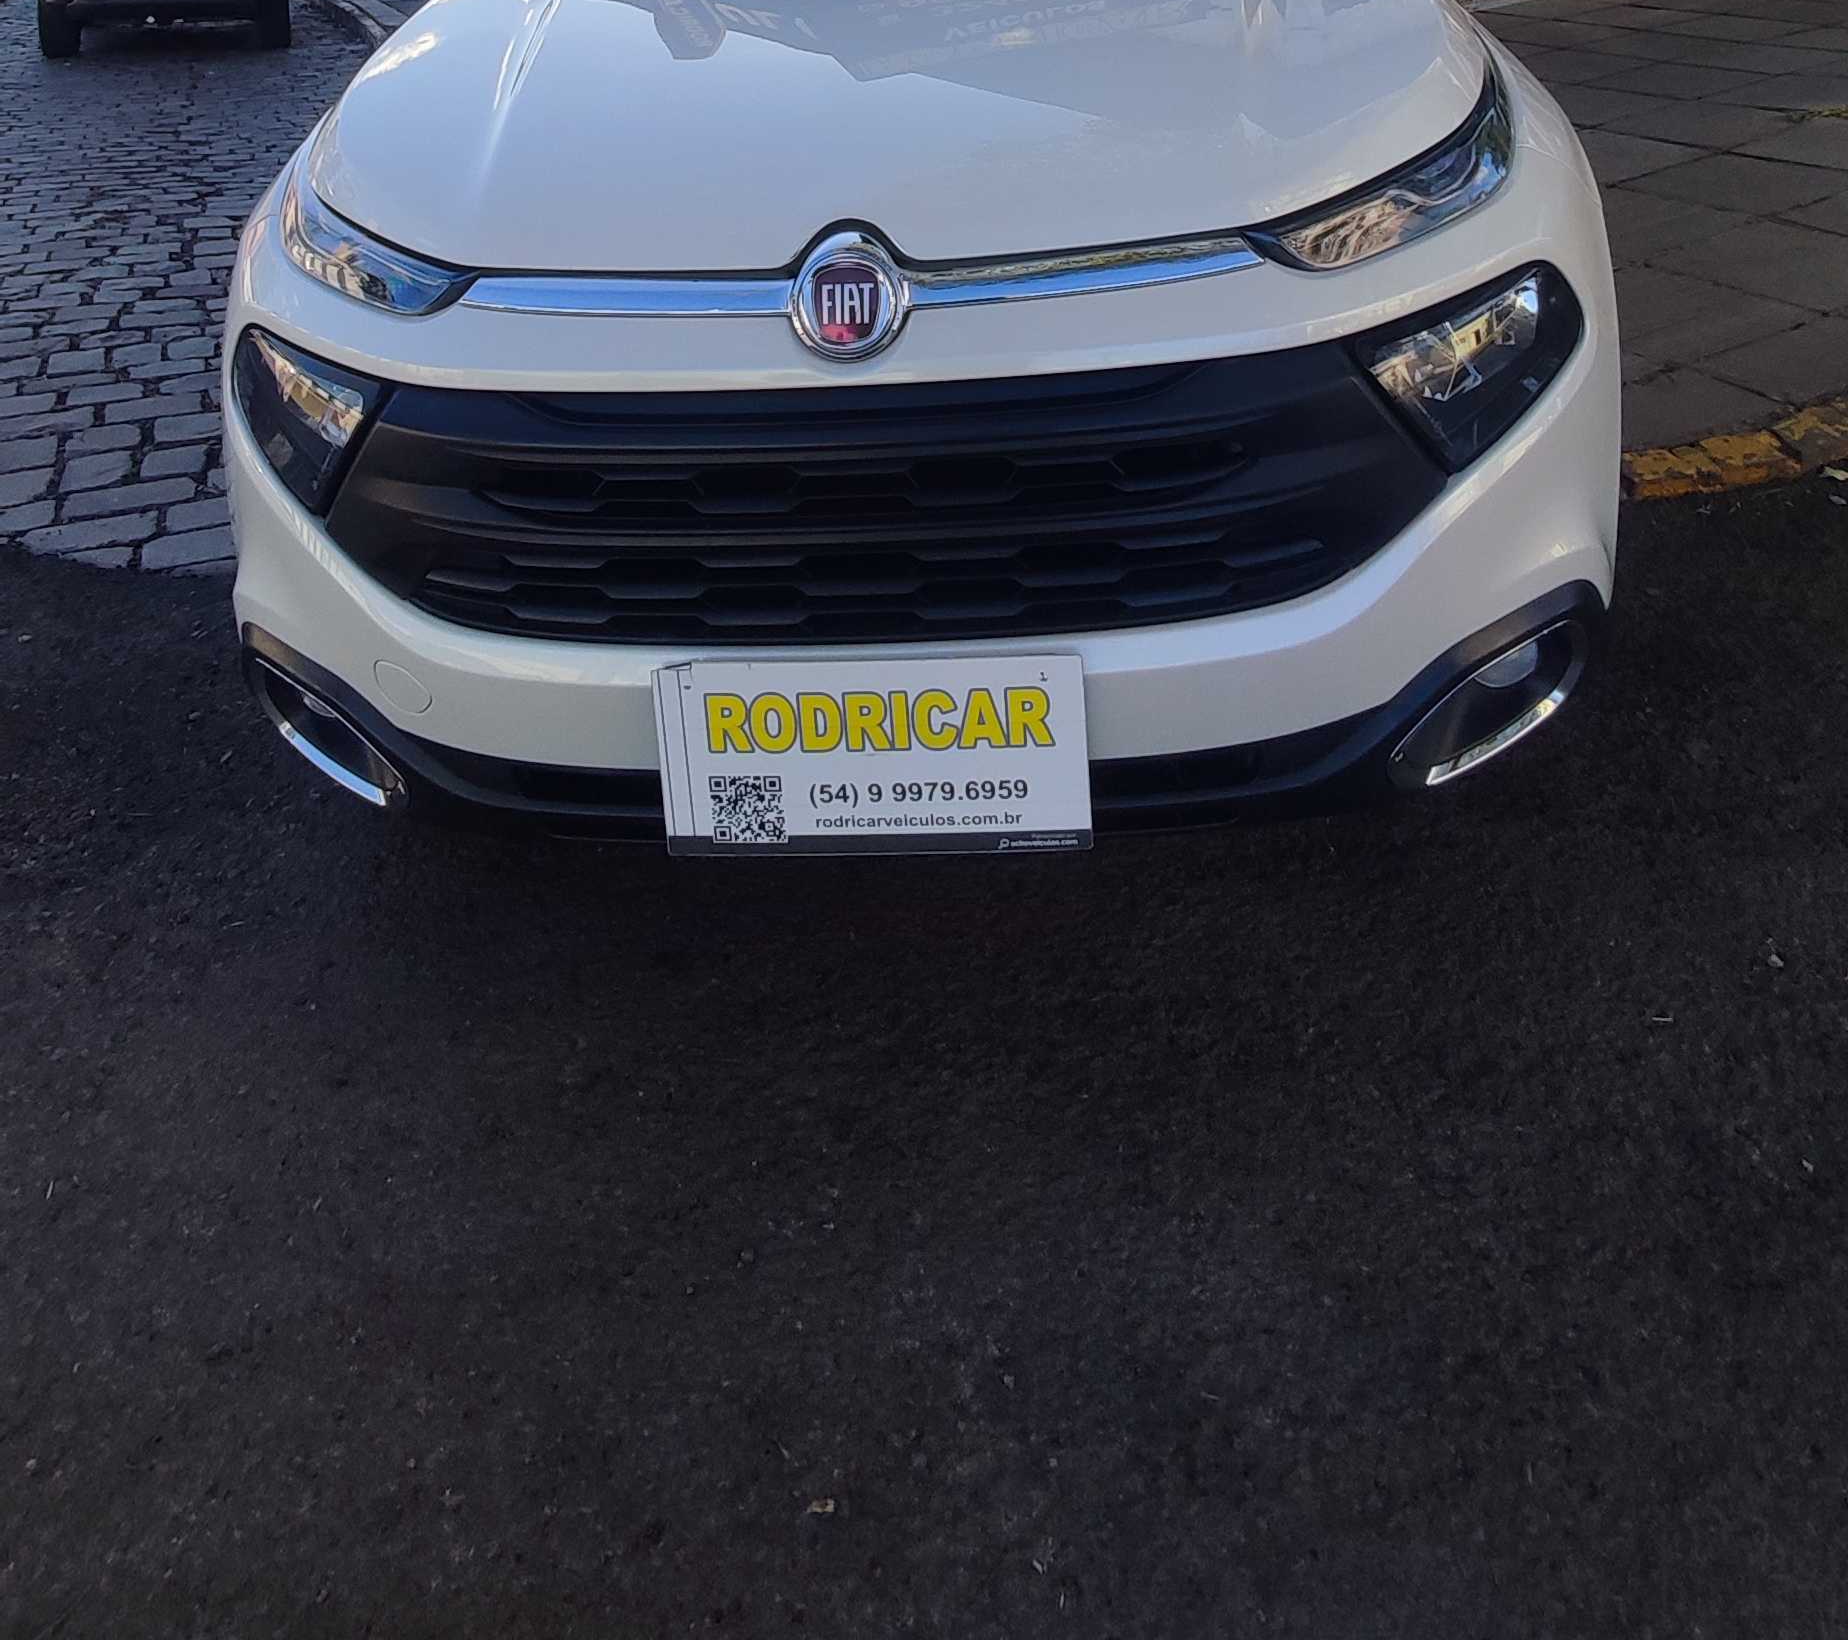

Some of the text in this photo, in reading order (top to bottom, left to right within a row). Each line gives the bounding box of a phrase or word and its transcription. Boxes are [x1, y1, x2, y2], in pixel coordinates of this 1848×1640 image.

[821, 283, 875, 325] FIAT
[703, 686, 1057, 754] RODRICAR
[809, 779, 1029, 808] (54) 9 9979.6959
[815, 811, 1024, 828] rodricarveiculos.com.br
